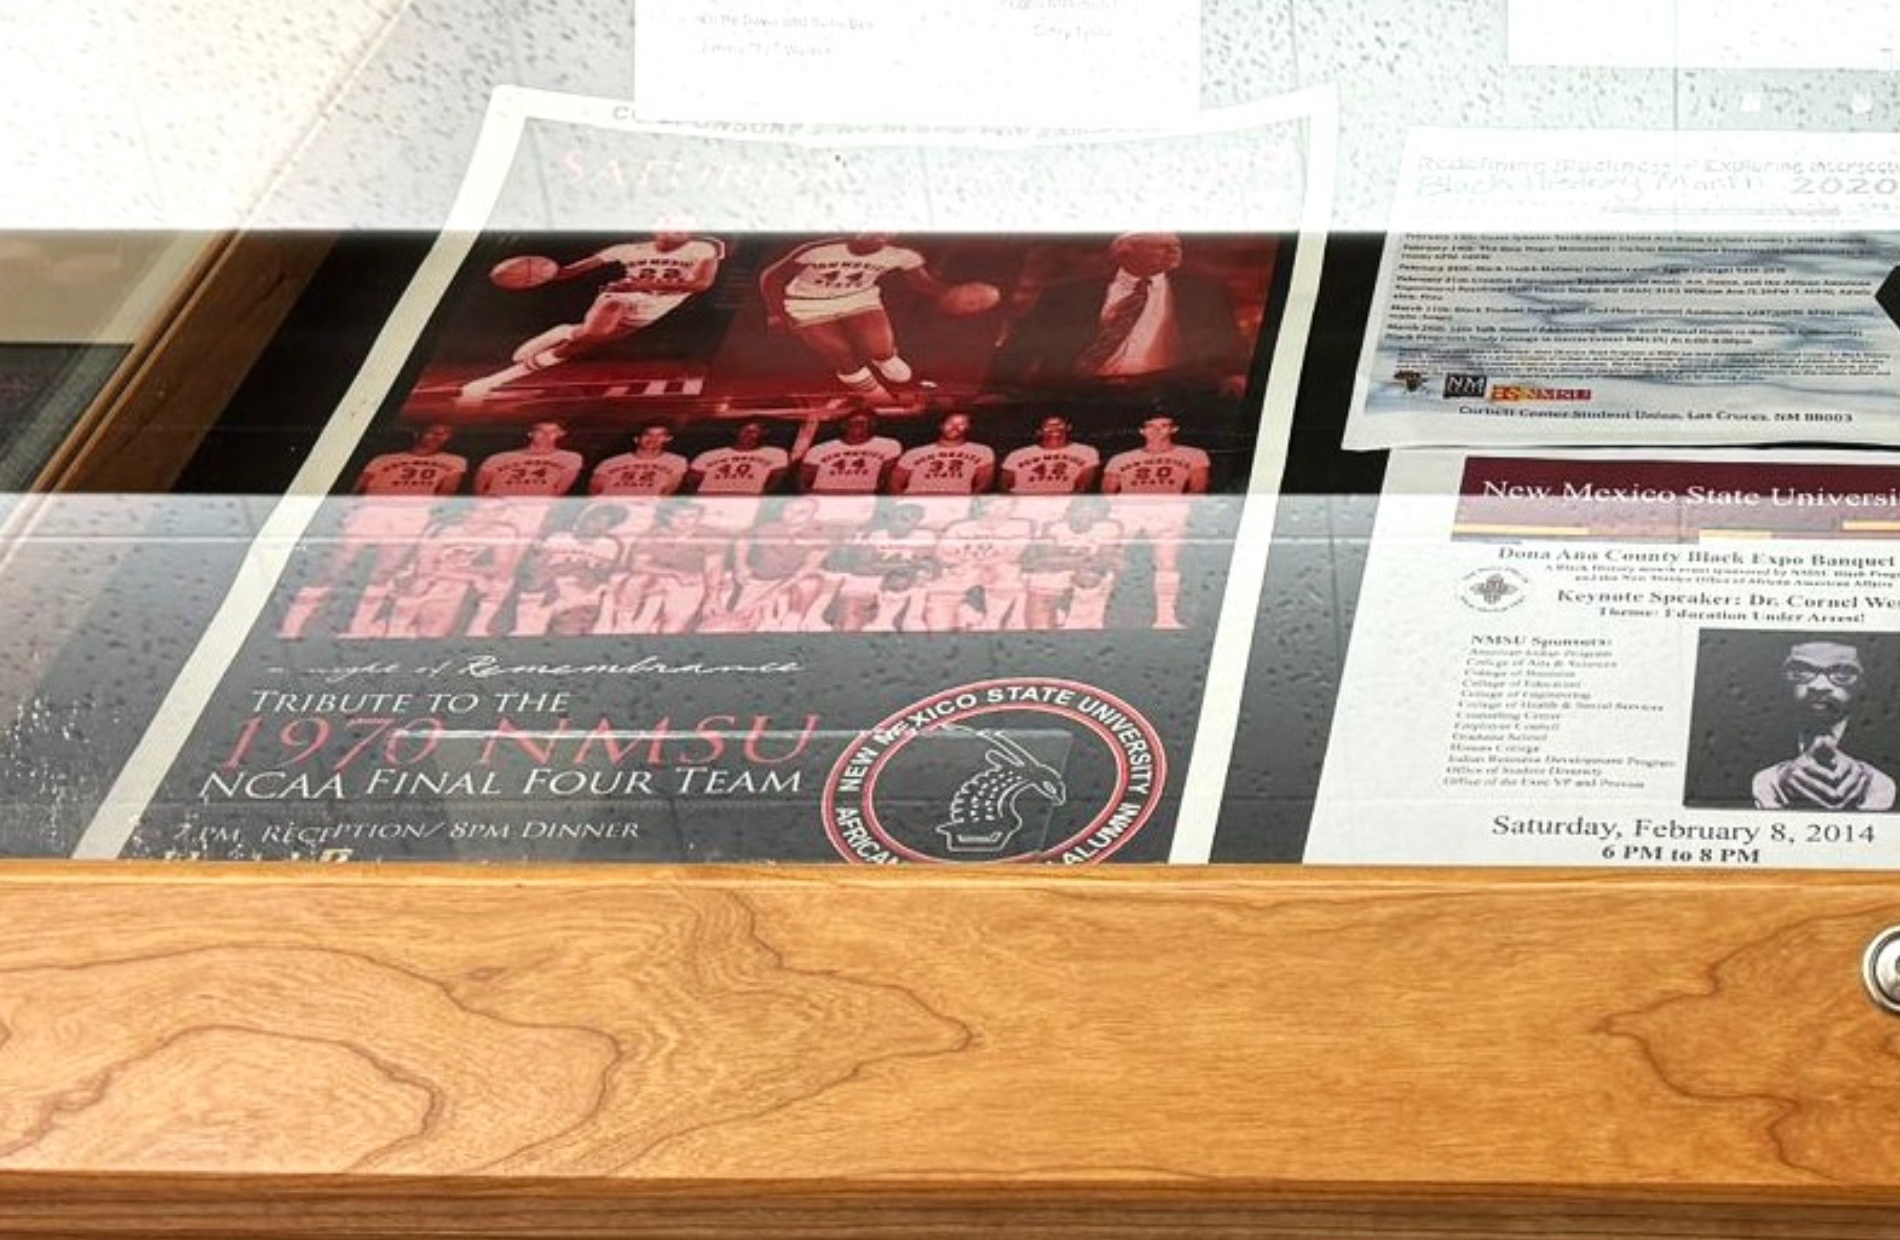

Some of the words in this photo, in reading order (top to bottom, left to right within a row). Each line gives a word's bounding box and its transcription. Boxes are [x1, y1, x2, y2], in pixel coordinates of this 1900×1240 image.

[1483, 481, 1550, 501] New
[1563, 484, 1676, 504] Mexico
[1686, 487, 1761, 505] State
[1558, 590, 1641, 605] Keynote
[1649, 591, 1742, 608] Speaker:
[1750, 595, 1781, 607] Dr.
[1787, 595, 1858, 609] Cornel
[220, 715, 444, 772] 1970
[479, 714, 821, 765] NMSU
[840, 747, 878, 792] NEW
[874, 693, 977, 747] MEXICO
[986, 686, 1076, 706] STATE
[1077, 695, 1154, 795] UNIVERSITY
[200, 771, 344, 802] NCAA
[1062, 803, 1141, 865] ALUMNI
[1492, 816, 1622, 839] Saturday,
[1635, 819, 1760, 843] February
[1771, 823, 1795, 844] 8,
[1806, 824, 1875, 843] 2014
[1602, 845, 1615, 859] 6
[1623, 846, 1663, 860] PM
[1671, 848, 1692, 861] to
[1700, 848, 1712, 861] 8
[1720, 848, 1760, 863] PM
